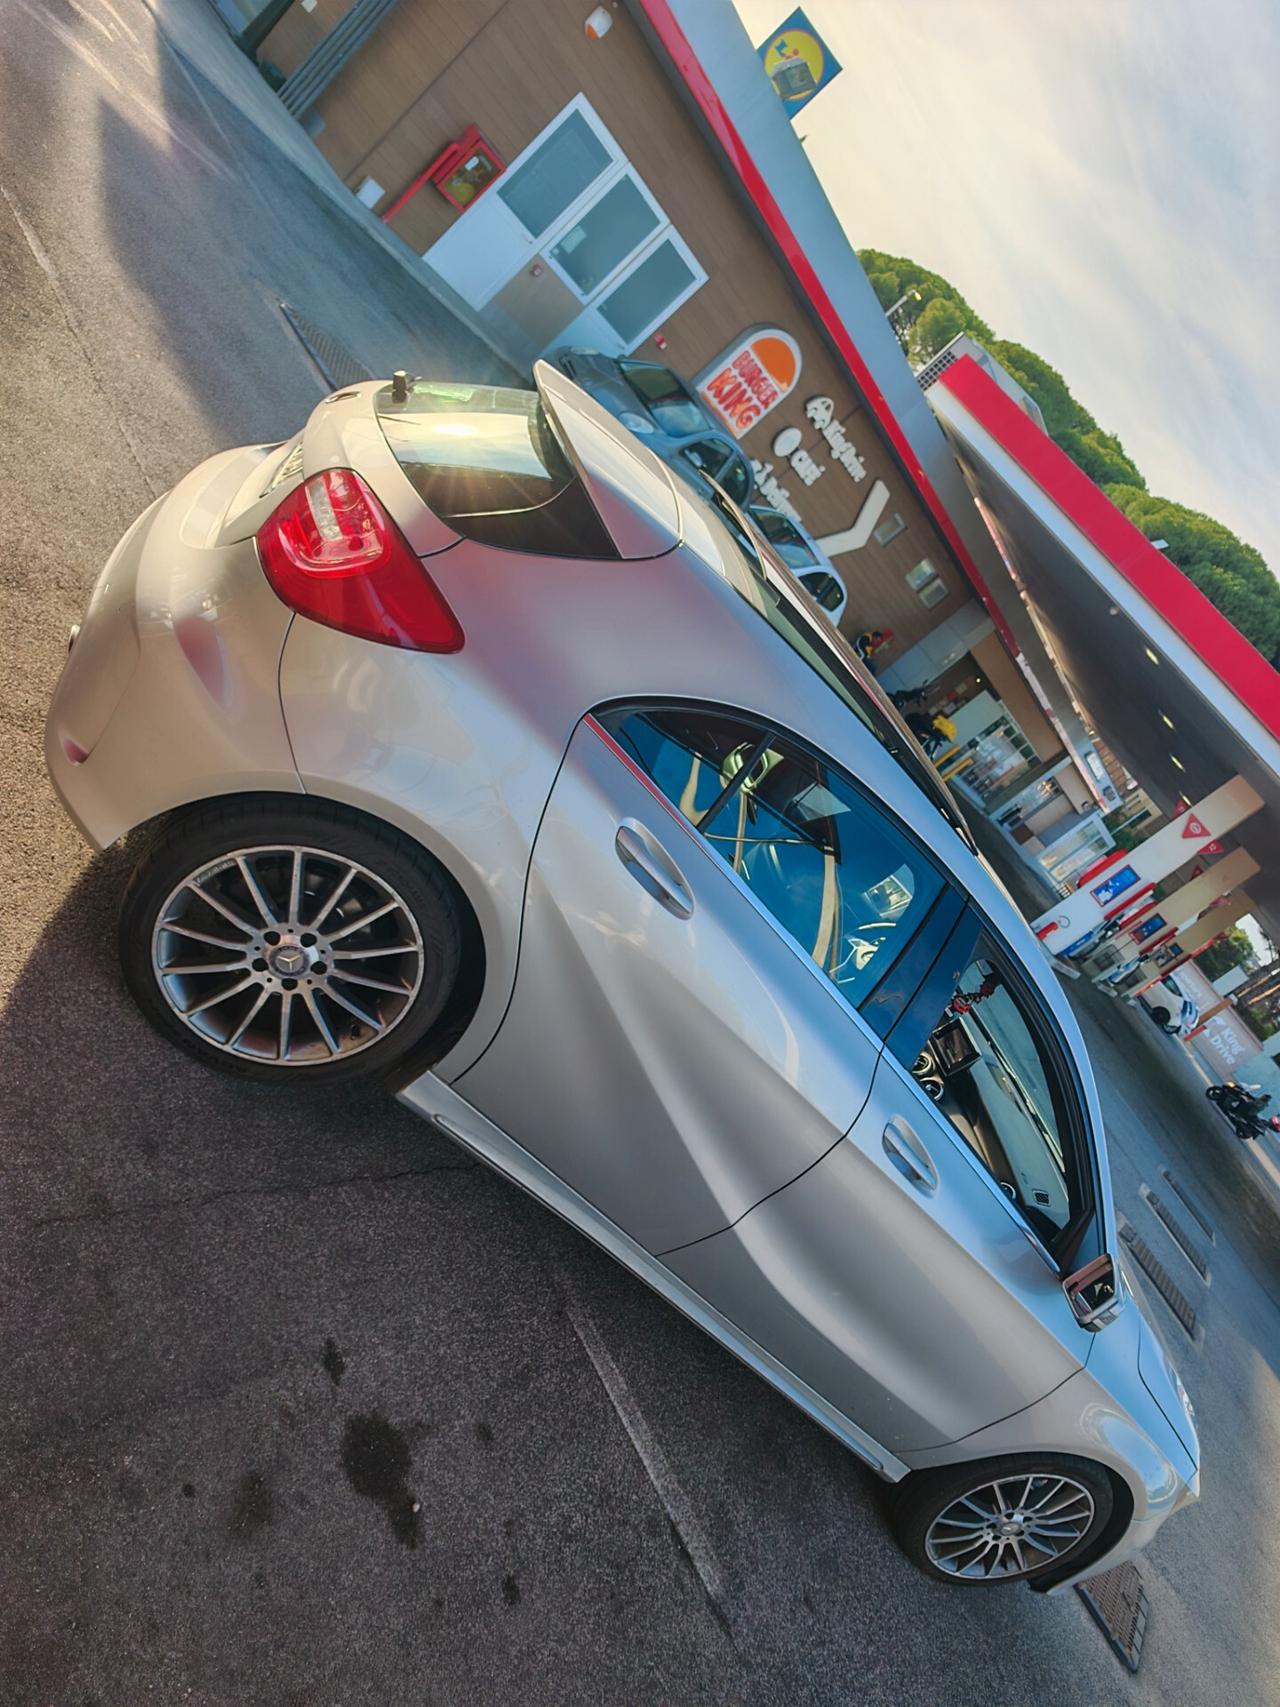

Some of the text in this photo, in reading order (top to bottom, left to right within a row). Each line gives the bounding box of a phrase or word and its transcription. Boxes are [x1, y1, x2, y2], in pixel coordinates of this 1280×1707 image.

[706, 367, 761, 431] KING
[732, 350, 779, 411] BURGER
[822, 418, 867, 483] King Drive
[1211, 1034, 1235, 1065] Drive
[1221, 1026, 1246, 1056] King
